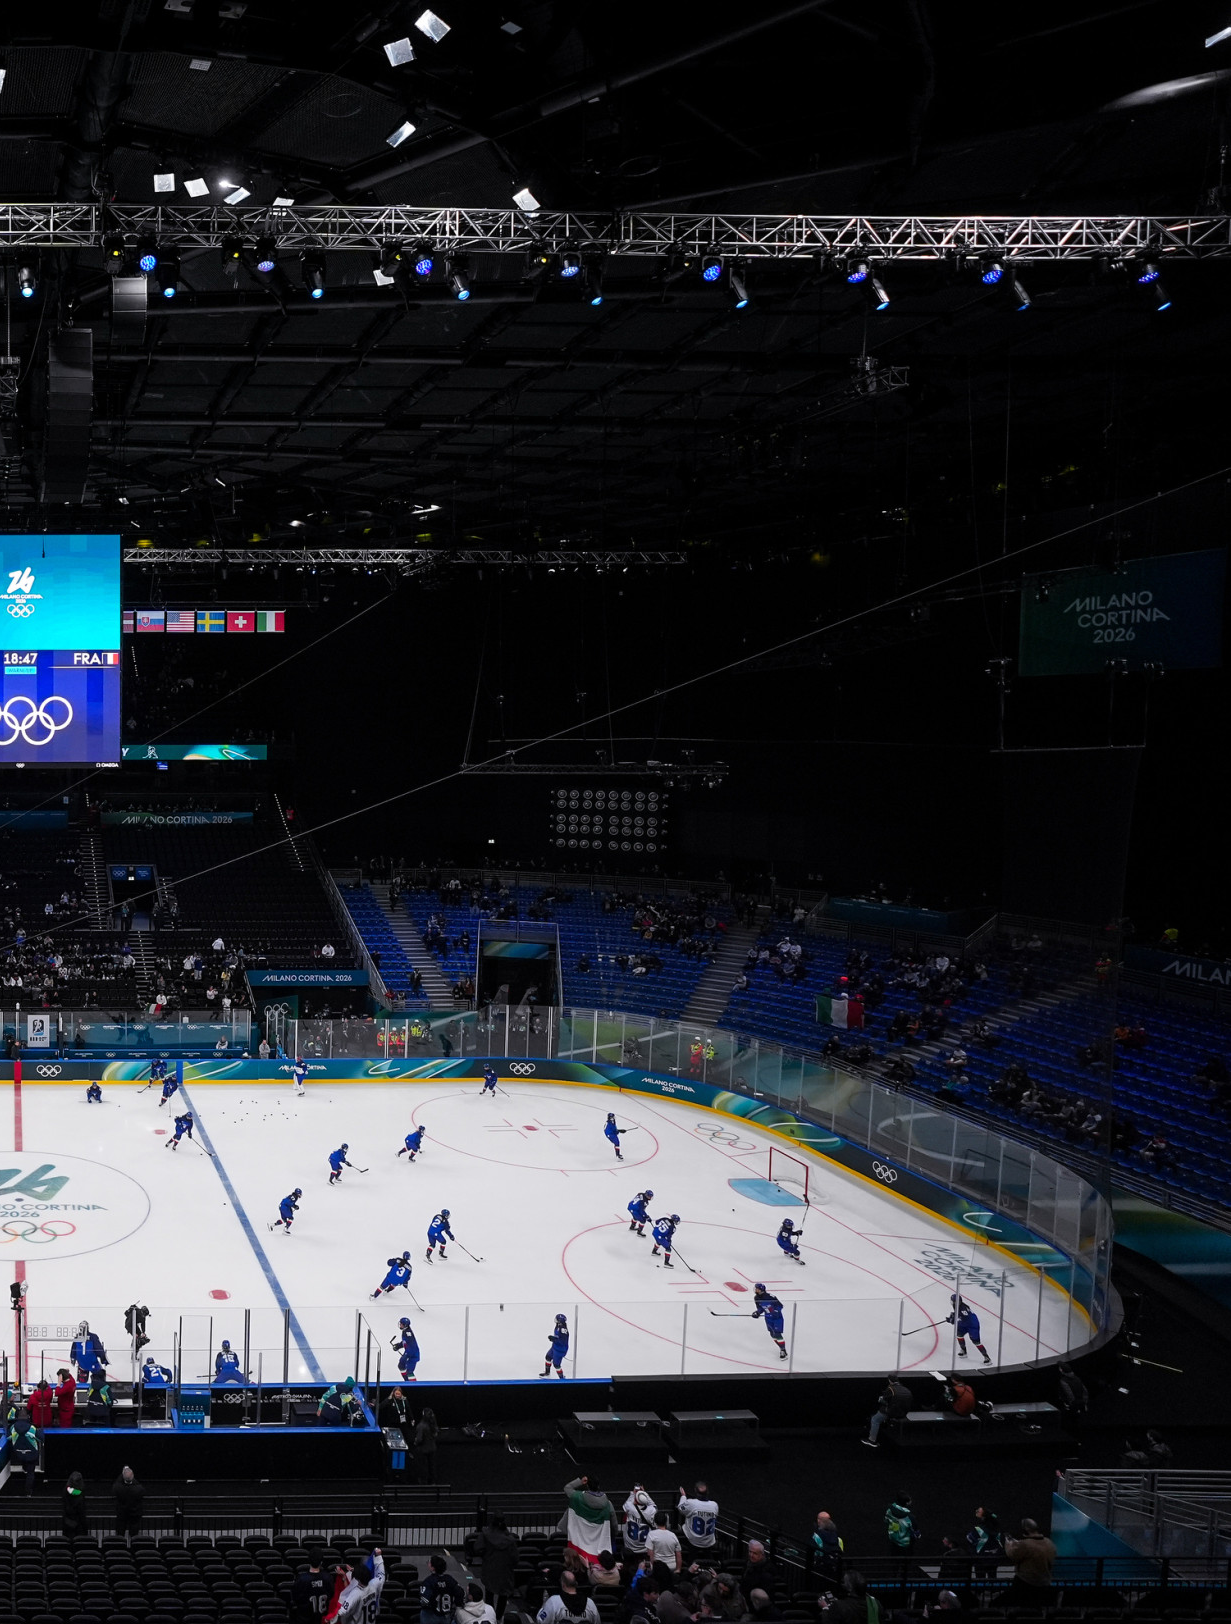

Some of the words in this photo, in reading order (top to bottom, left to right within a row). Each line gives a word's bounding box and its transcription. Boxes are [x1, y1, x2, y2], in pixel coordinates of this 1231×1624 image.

[1063, 591, 1153, 613] MILANO
[1077, 608, 1171, 628] CORTINA
[1093, 627, 1136, 643] 2026
[3, 652, 38, 665] 18:47
[74, 652, 102, 665] FRA
[166, 816, 210, 824] CORTINA
[212, 816, 233, 824] 2026
[298, 974, 334, 982] CORTINA
[335, 974, 352, 982] 2026
[641, 1077, 668, 1087] MILANO
[668, 1081, 696, 1093] CORTINA
[396, 1266, 406, 1277] 3
[925, 1243, 1015, 1288] MILANO
[692, 1516, 716, 1536] 82
